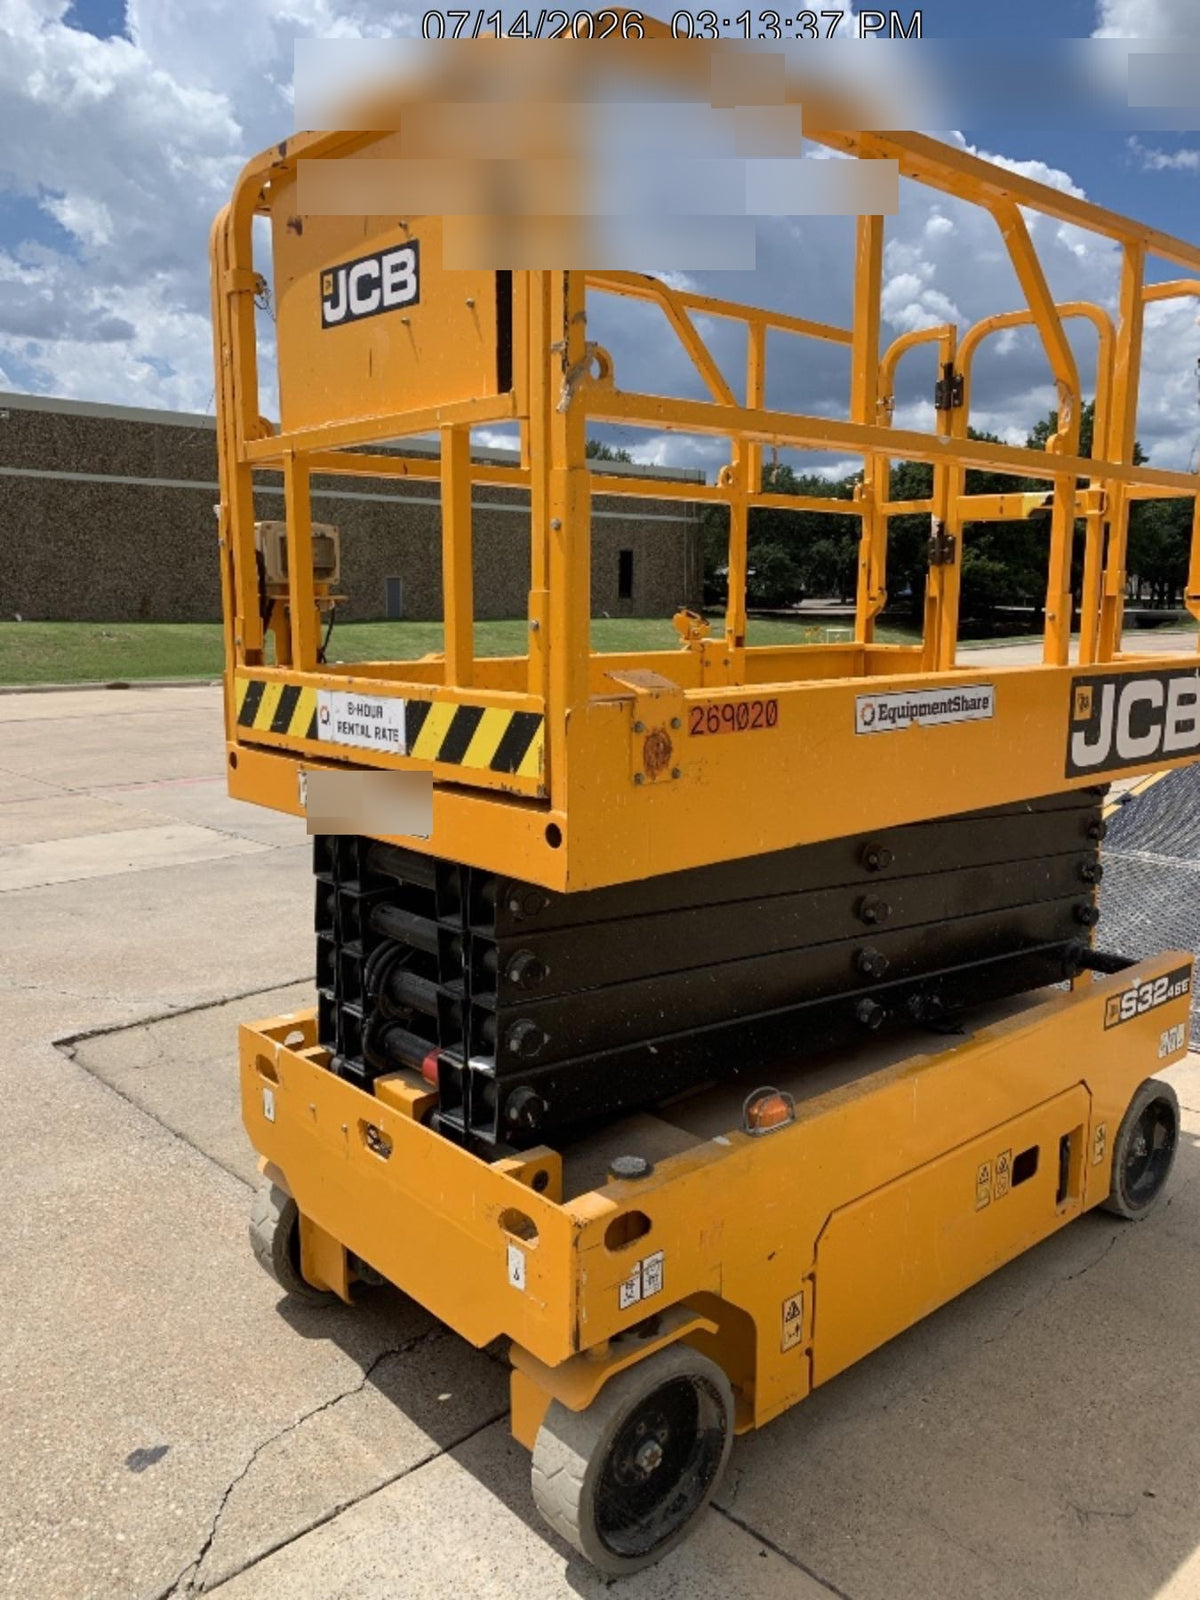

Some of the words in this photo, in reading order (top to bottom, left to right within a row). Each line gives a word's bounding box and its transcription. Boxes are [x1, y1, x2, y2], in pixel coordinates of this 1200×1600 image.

[323, 247, 417, 322] JCB
[690, 699, 779, 735] 269020
[878, 695, 990, 724] EquipmentShare
[1071, 676, 1200, 768] JCB
[336, 721, 372, 739] RENTAL
[374, 726, 400, 743] RATE
